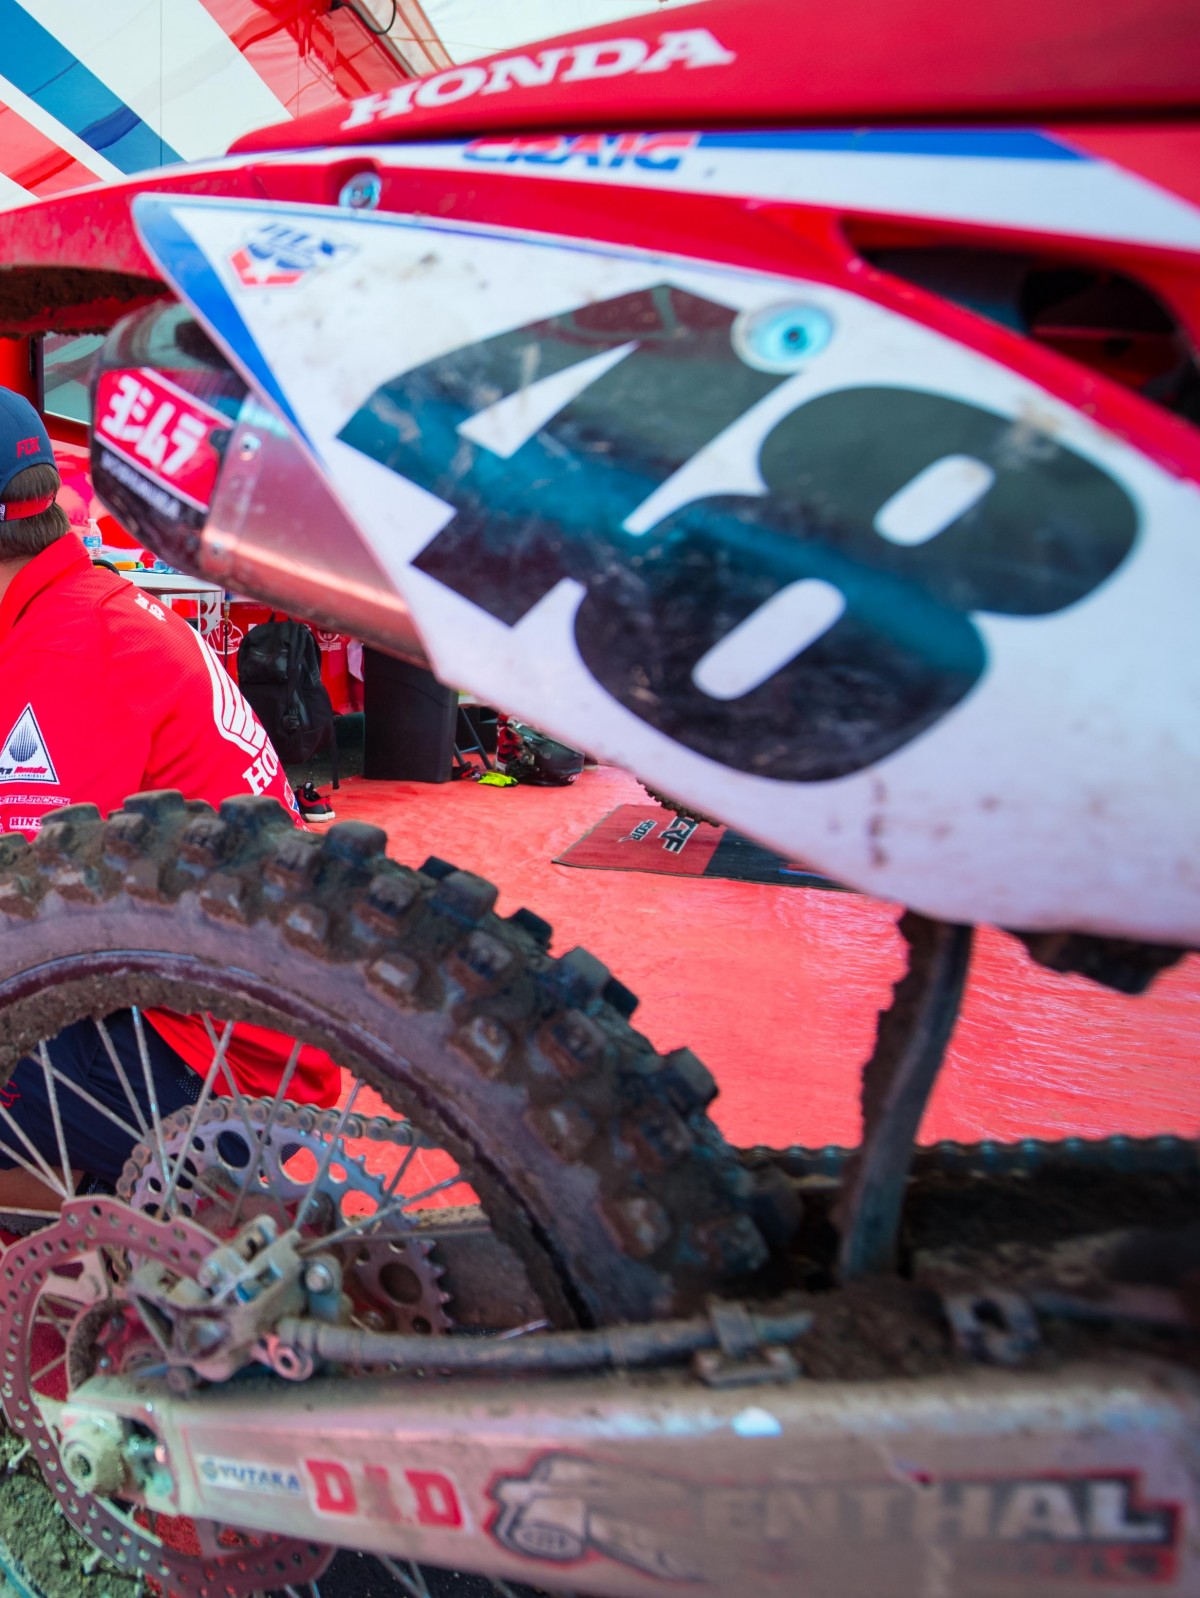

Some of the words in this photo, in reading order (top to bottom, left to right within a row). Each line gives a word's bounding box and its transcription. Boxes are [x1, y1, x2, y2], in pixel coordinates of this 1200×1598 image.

[340, 27, 737, 132] HONDA
[16, 435, 41, 459] FOX
[336, 282, 1142, 783] 48
[219, 1465, 301, 1491] YUTAKA
[700, 1476, 1166, 1543] ENTHAL
